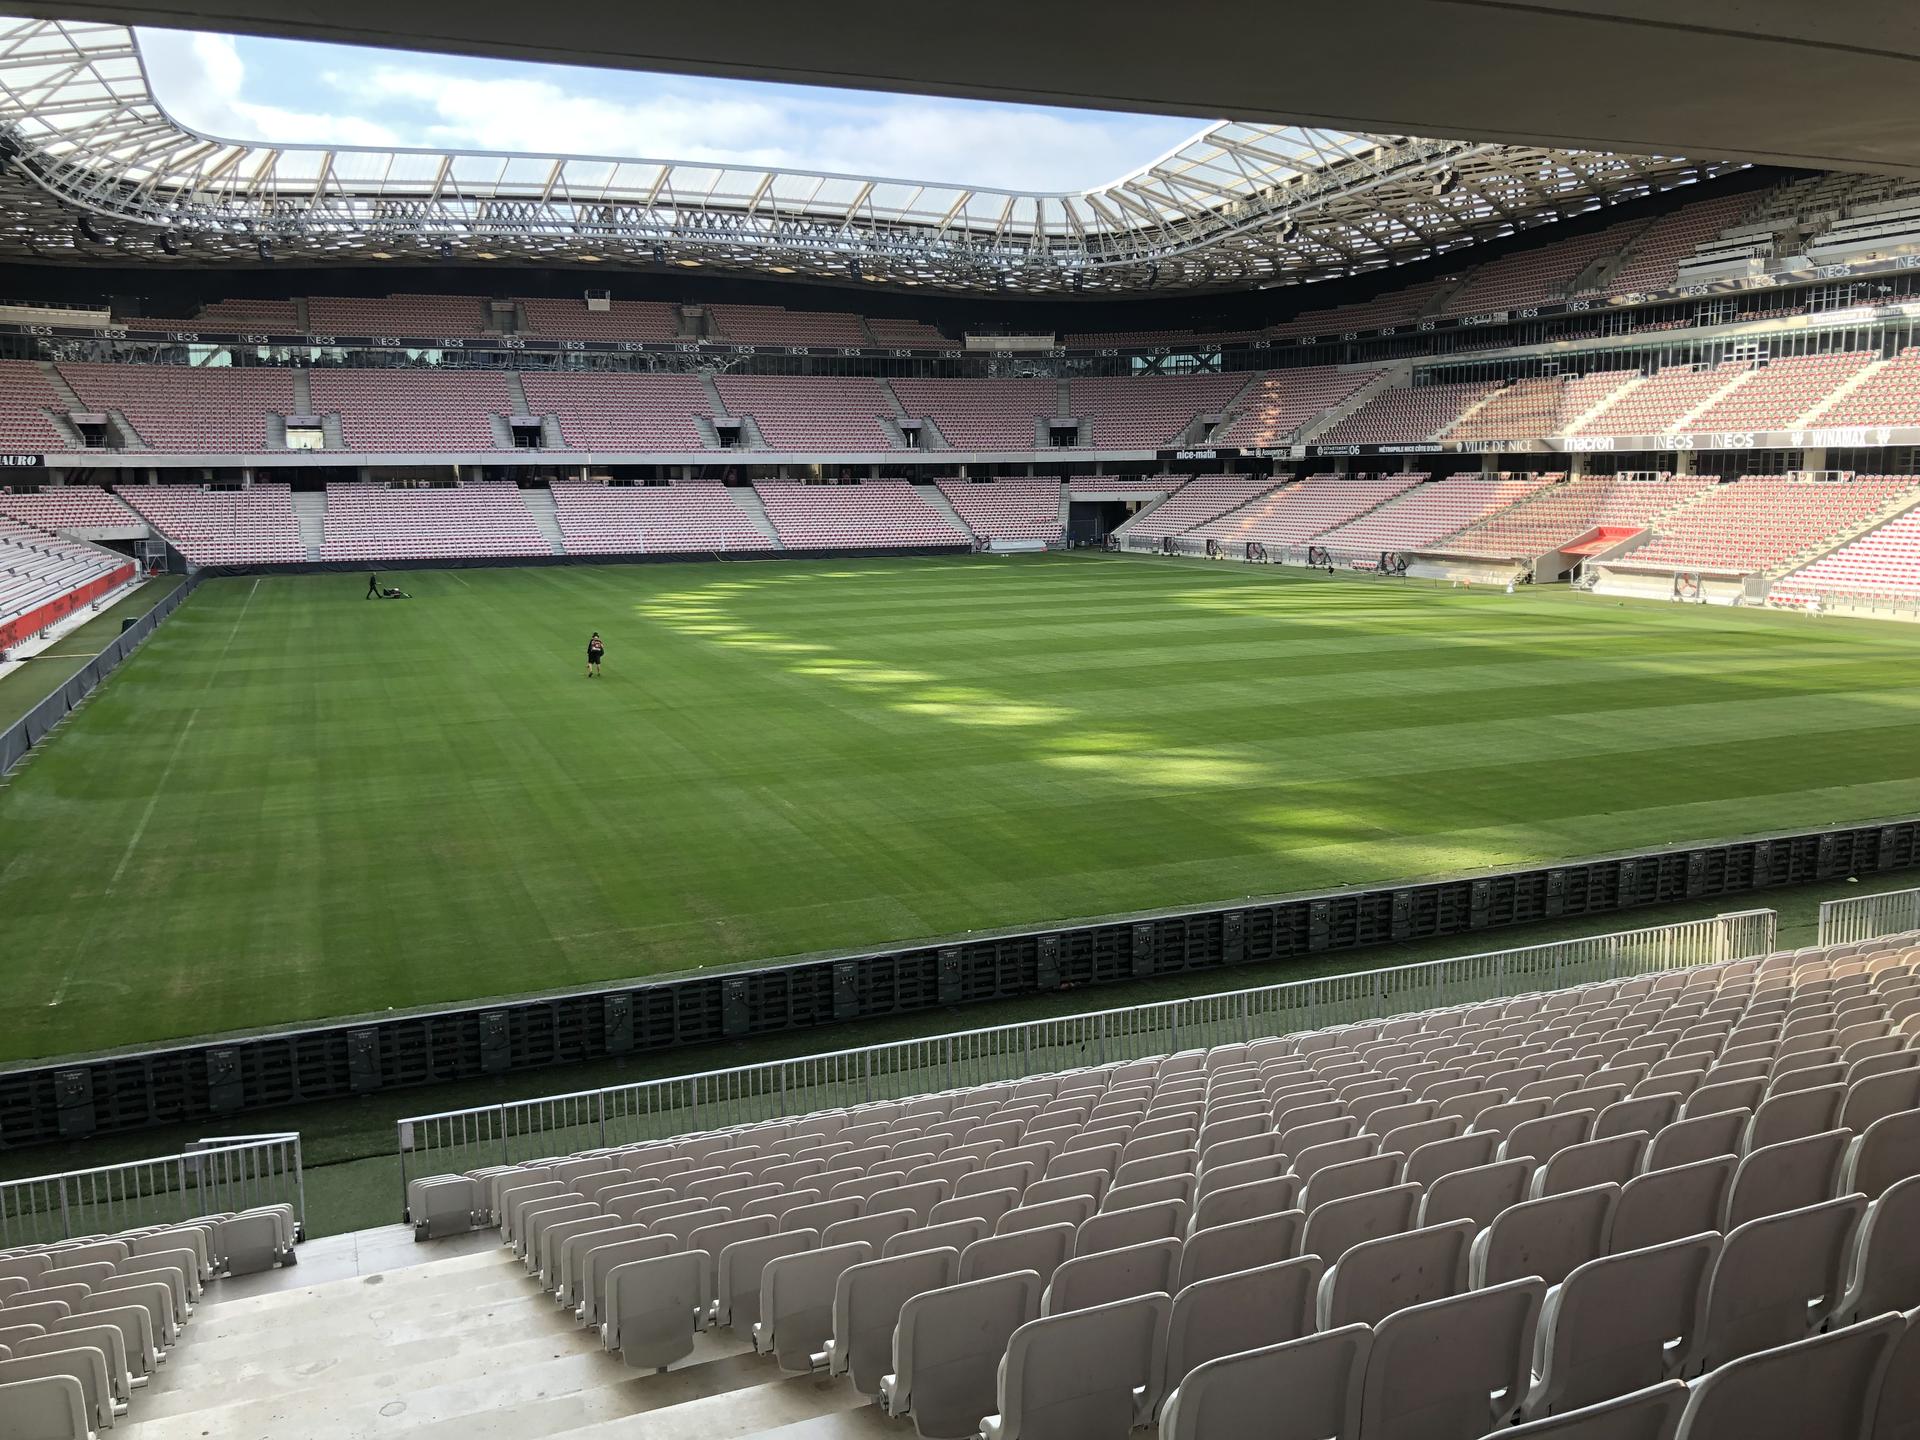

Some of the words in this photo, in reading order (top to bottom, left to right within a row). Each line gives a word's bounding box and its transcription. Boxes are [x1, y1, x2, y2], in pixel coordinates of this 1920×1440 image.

[1818, 264, 1850, 279] INEOS
[1747, 276, 1776, 289] INEOS
[1681, 284, 1708, 297] INEOS
[1621, 294, 1647, 305] INEOS
[1566, 301, 1590, 313] INEOS
[1516, 308, 1538, 319] INEOS
[20, 325, 52, 335] INEOS
[95, 328, 126, 339] INEOS
[168, 332, 199, 341] INEOS
[239, 335, 268, 343] INEOS
[307, 336, 335, 344] INEOS
[373, 338, 400, 346] INEOS
[437, 339, 463, 347] INEOS
[499, 340, 525, 348] INEOS
[559, 341, 585, 349] INEOS
[618, 343, 643, 351] INEOS
[675, 343, 699, 352] INEOS
[731, 345, 754, 354] INEOS
[785, 347, 808, 355] INEOS
[1148, 346, 1170, 355] INEOS
[1200, 344, 1222, 352] INEOS
[838, 348, 860, 357] INEOS
[889, 349, 911, 357] INEOS
[939, 350, 962, 358] INEOS
[990, 351, 1013, 359] INEOS
[1042, 350, 1065, 358] INEOS
[1095, 349, 1118, 357] INEOS
[1654, 435, 1694, 449] INEOS
[1711, 433, 1754, 448] INEOS
[1812, 430, 1866, 446] WINAMAX
[1465, 440, 1489, 452] VILLE
[1492, 440, 1506, 451] DE
[1509, 440, 1532, 451] NICE
[1564, 437, 1614, 450] macron
[1176, 449, 1217, 459] nice-matin
[1349, 445, 1360, 455] 06
[0, 456, 37, 465] AURO
